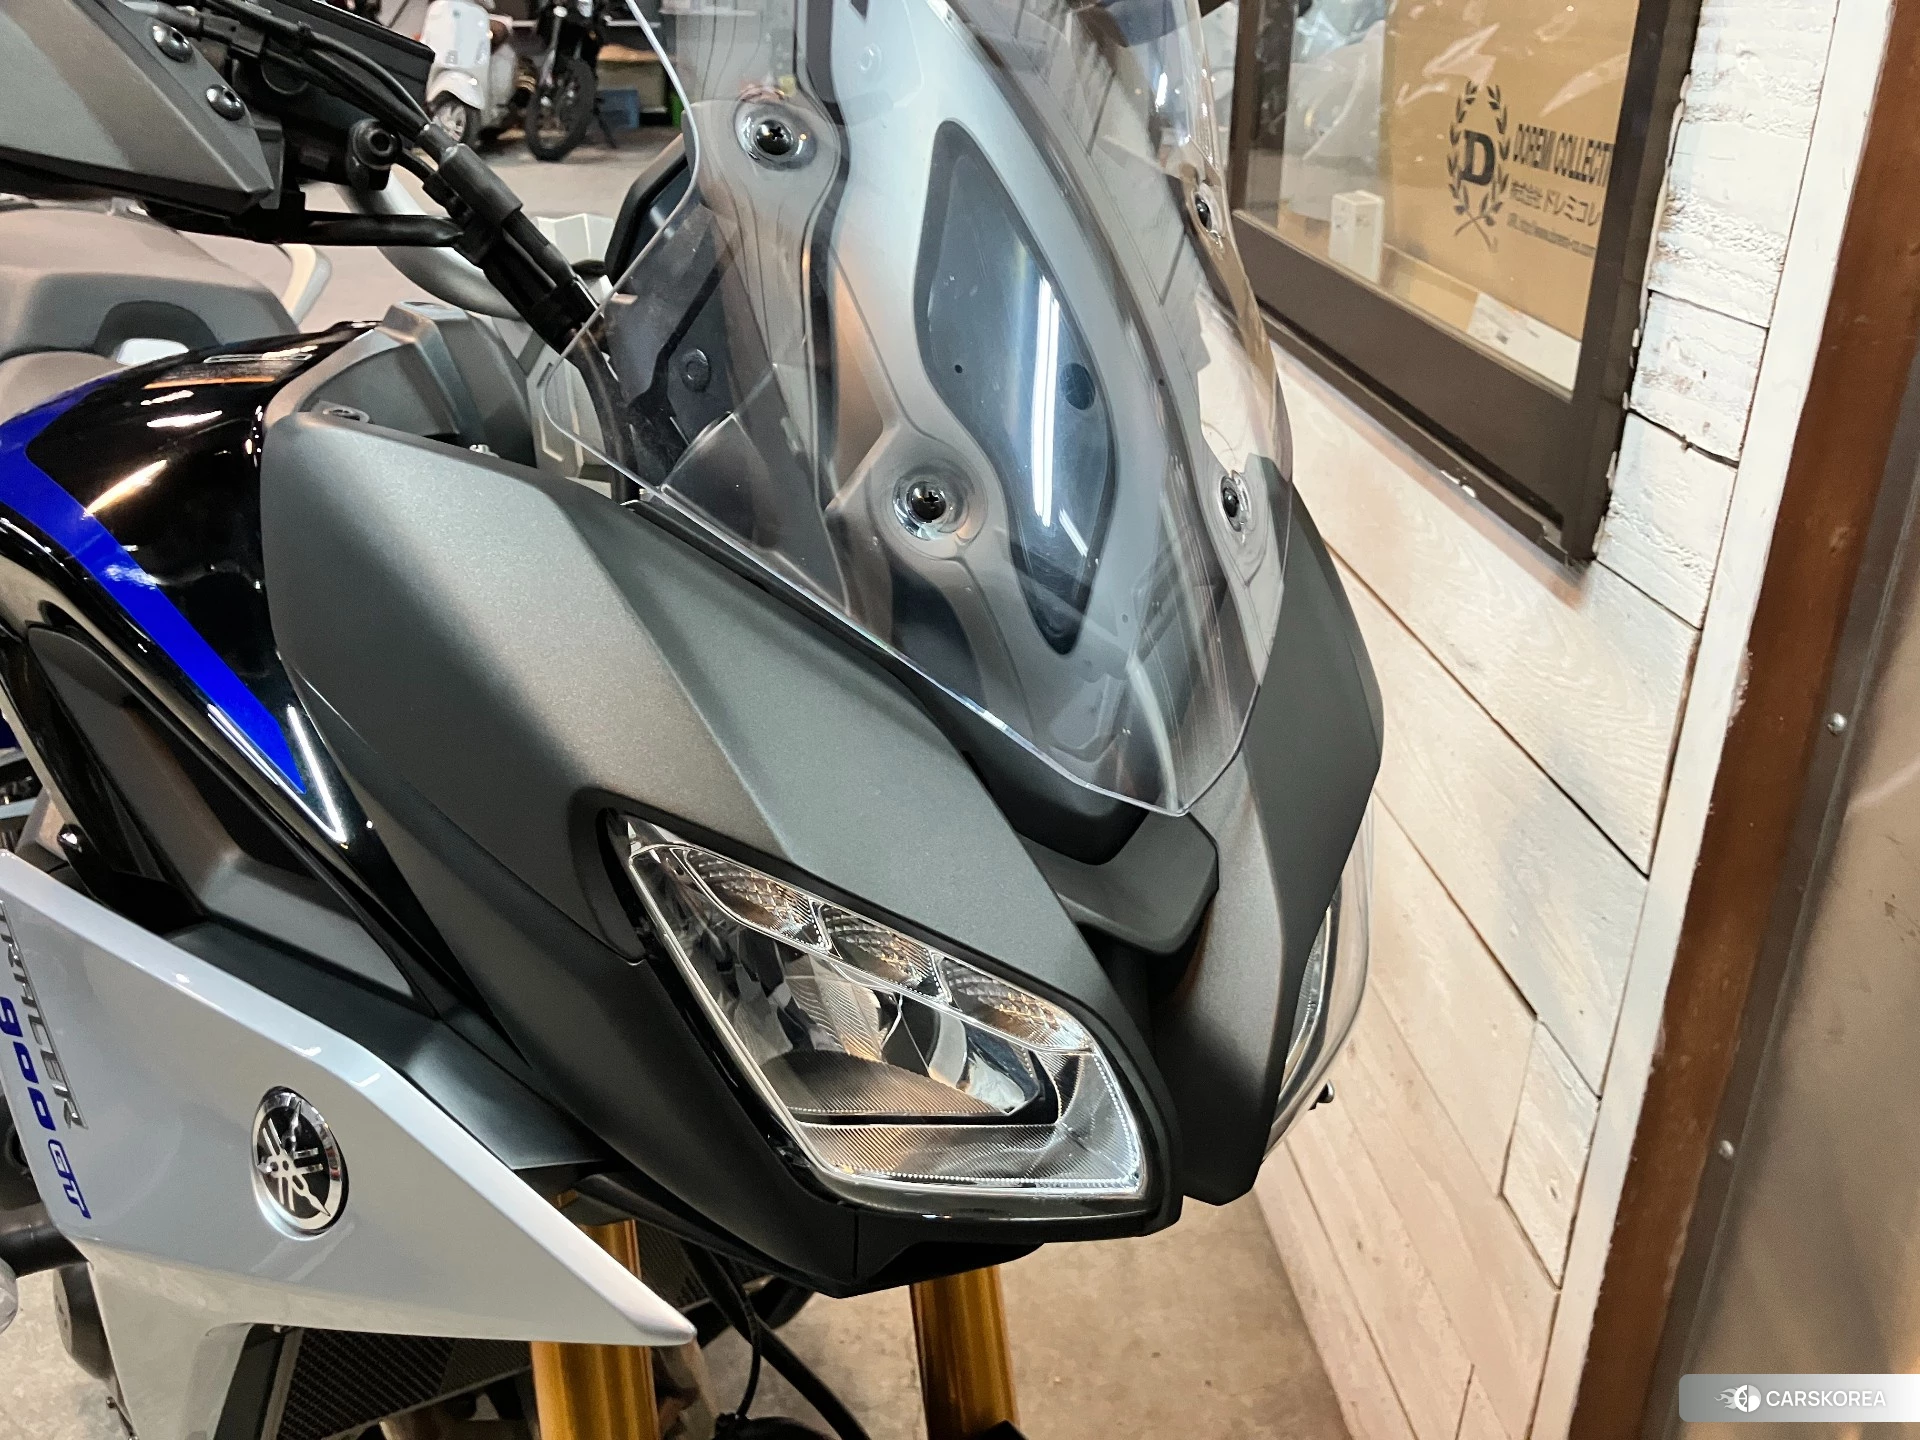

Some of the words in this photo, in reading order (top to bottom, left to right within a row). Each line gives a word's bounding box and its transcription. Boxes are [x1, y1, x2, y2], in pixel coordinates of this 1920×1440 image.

[1461, 129, 1496, 186] D
[0, 996, 56, 1131] 900
[48, 1139, 91, 1220] GT
